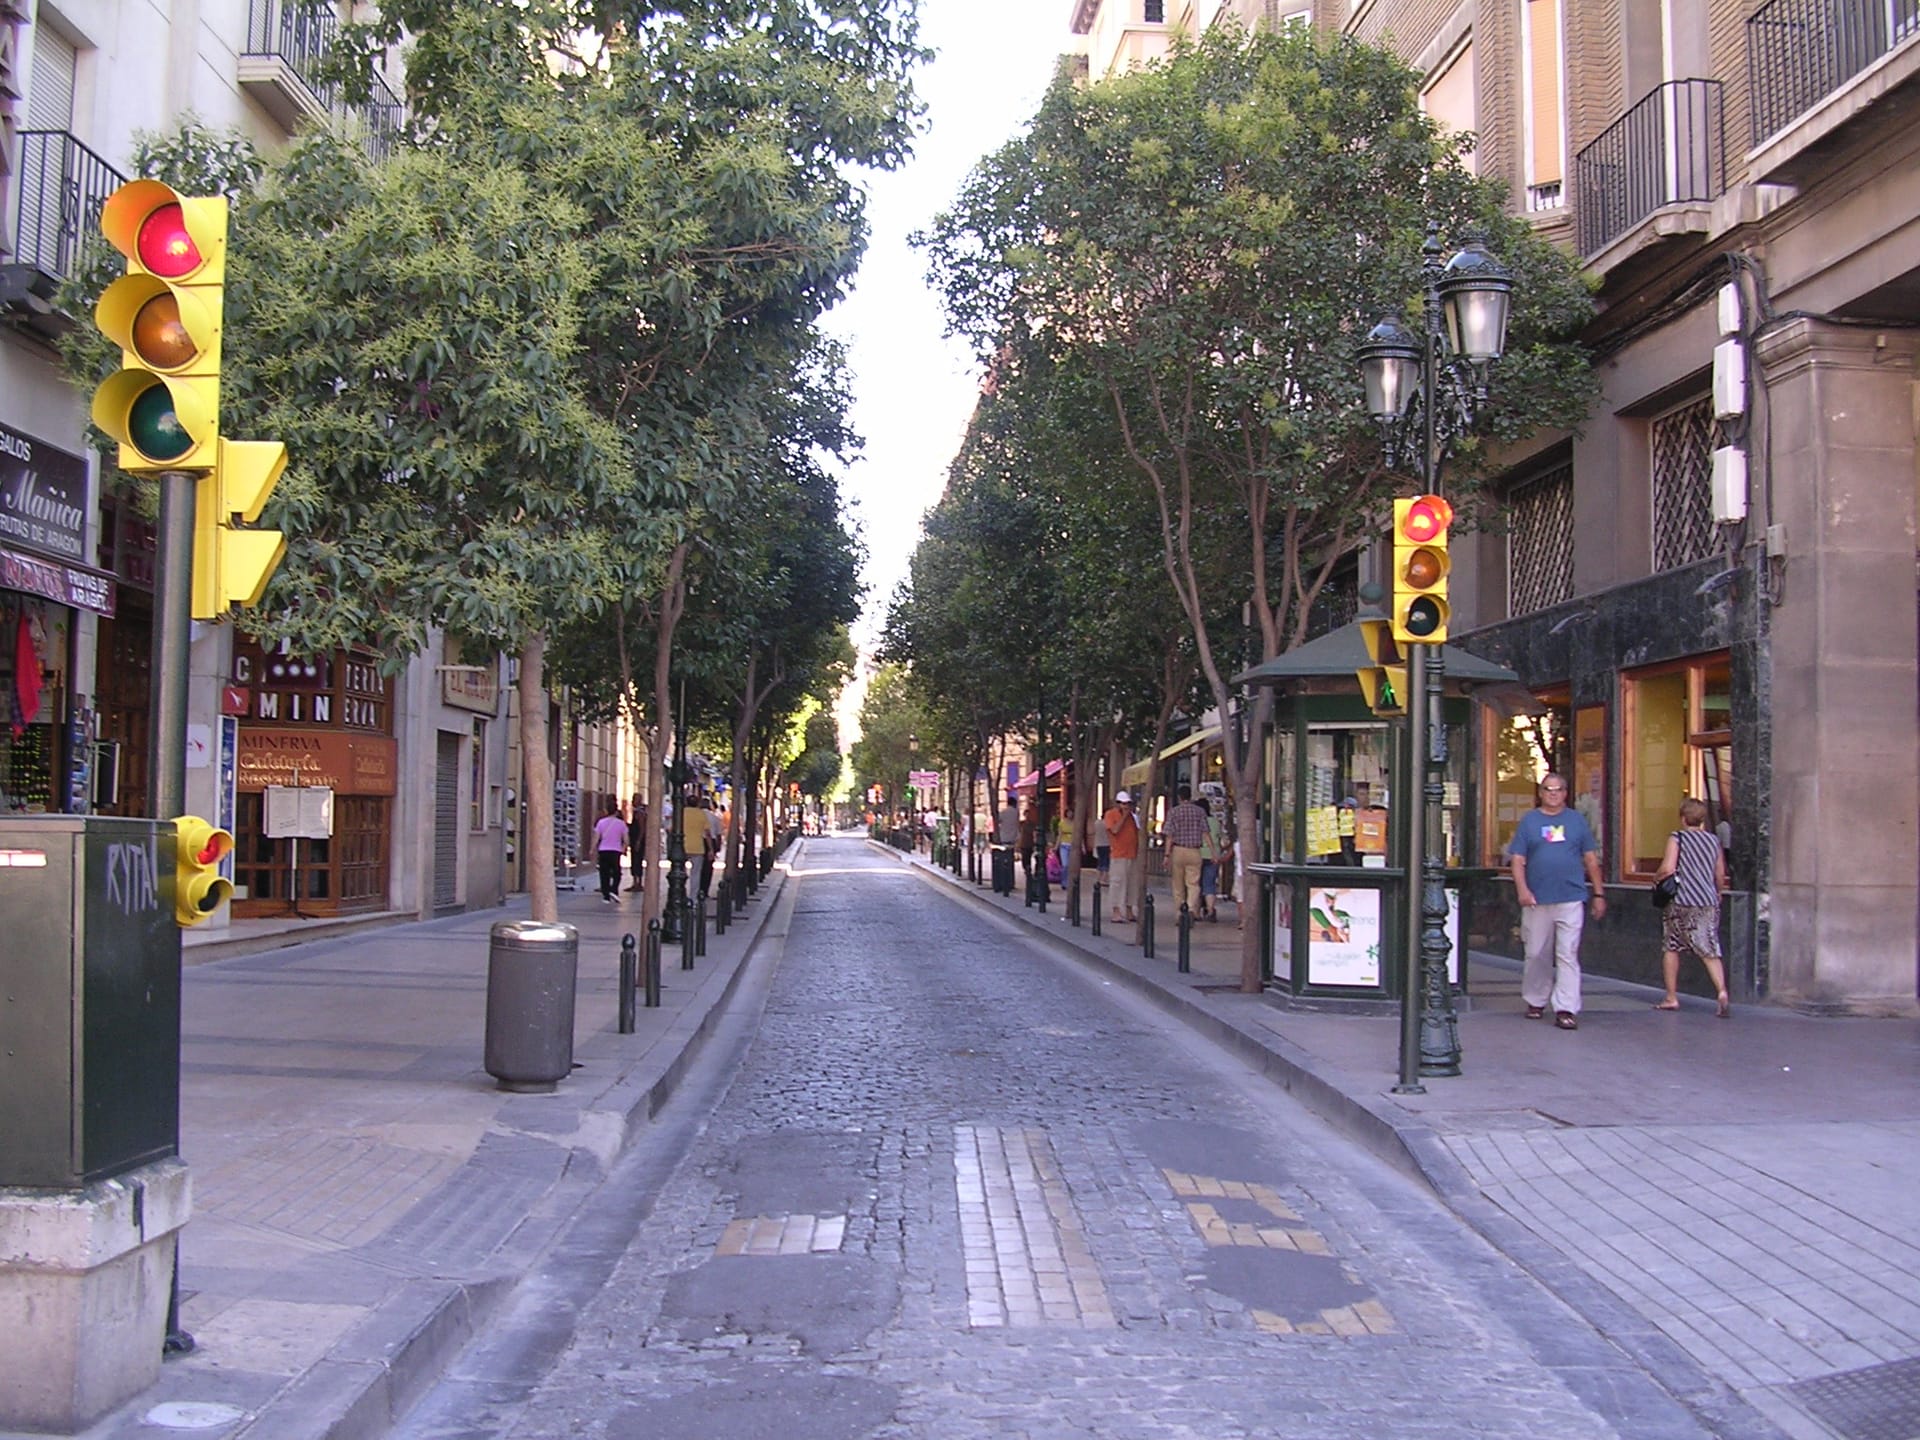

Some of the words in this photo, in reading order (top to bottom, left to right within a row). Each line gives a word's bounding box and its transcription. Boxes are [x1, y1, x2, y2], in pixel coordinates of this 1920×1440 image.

[6, 469, 82, 532] Mañica
[31, 523, 45, 543] DE
[242, 735, 322, 751] MINERVA
